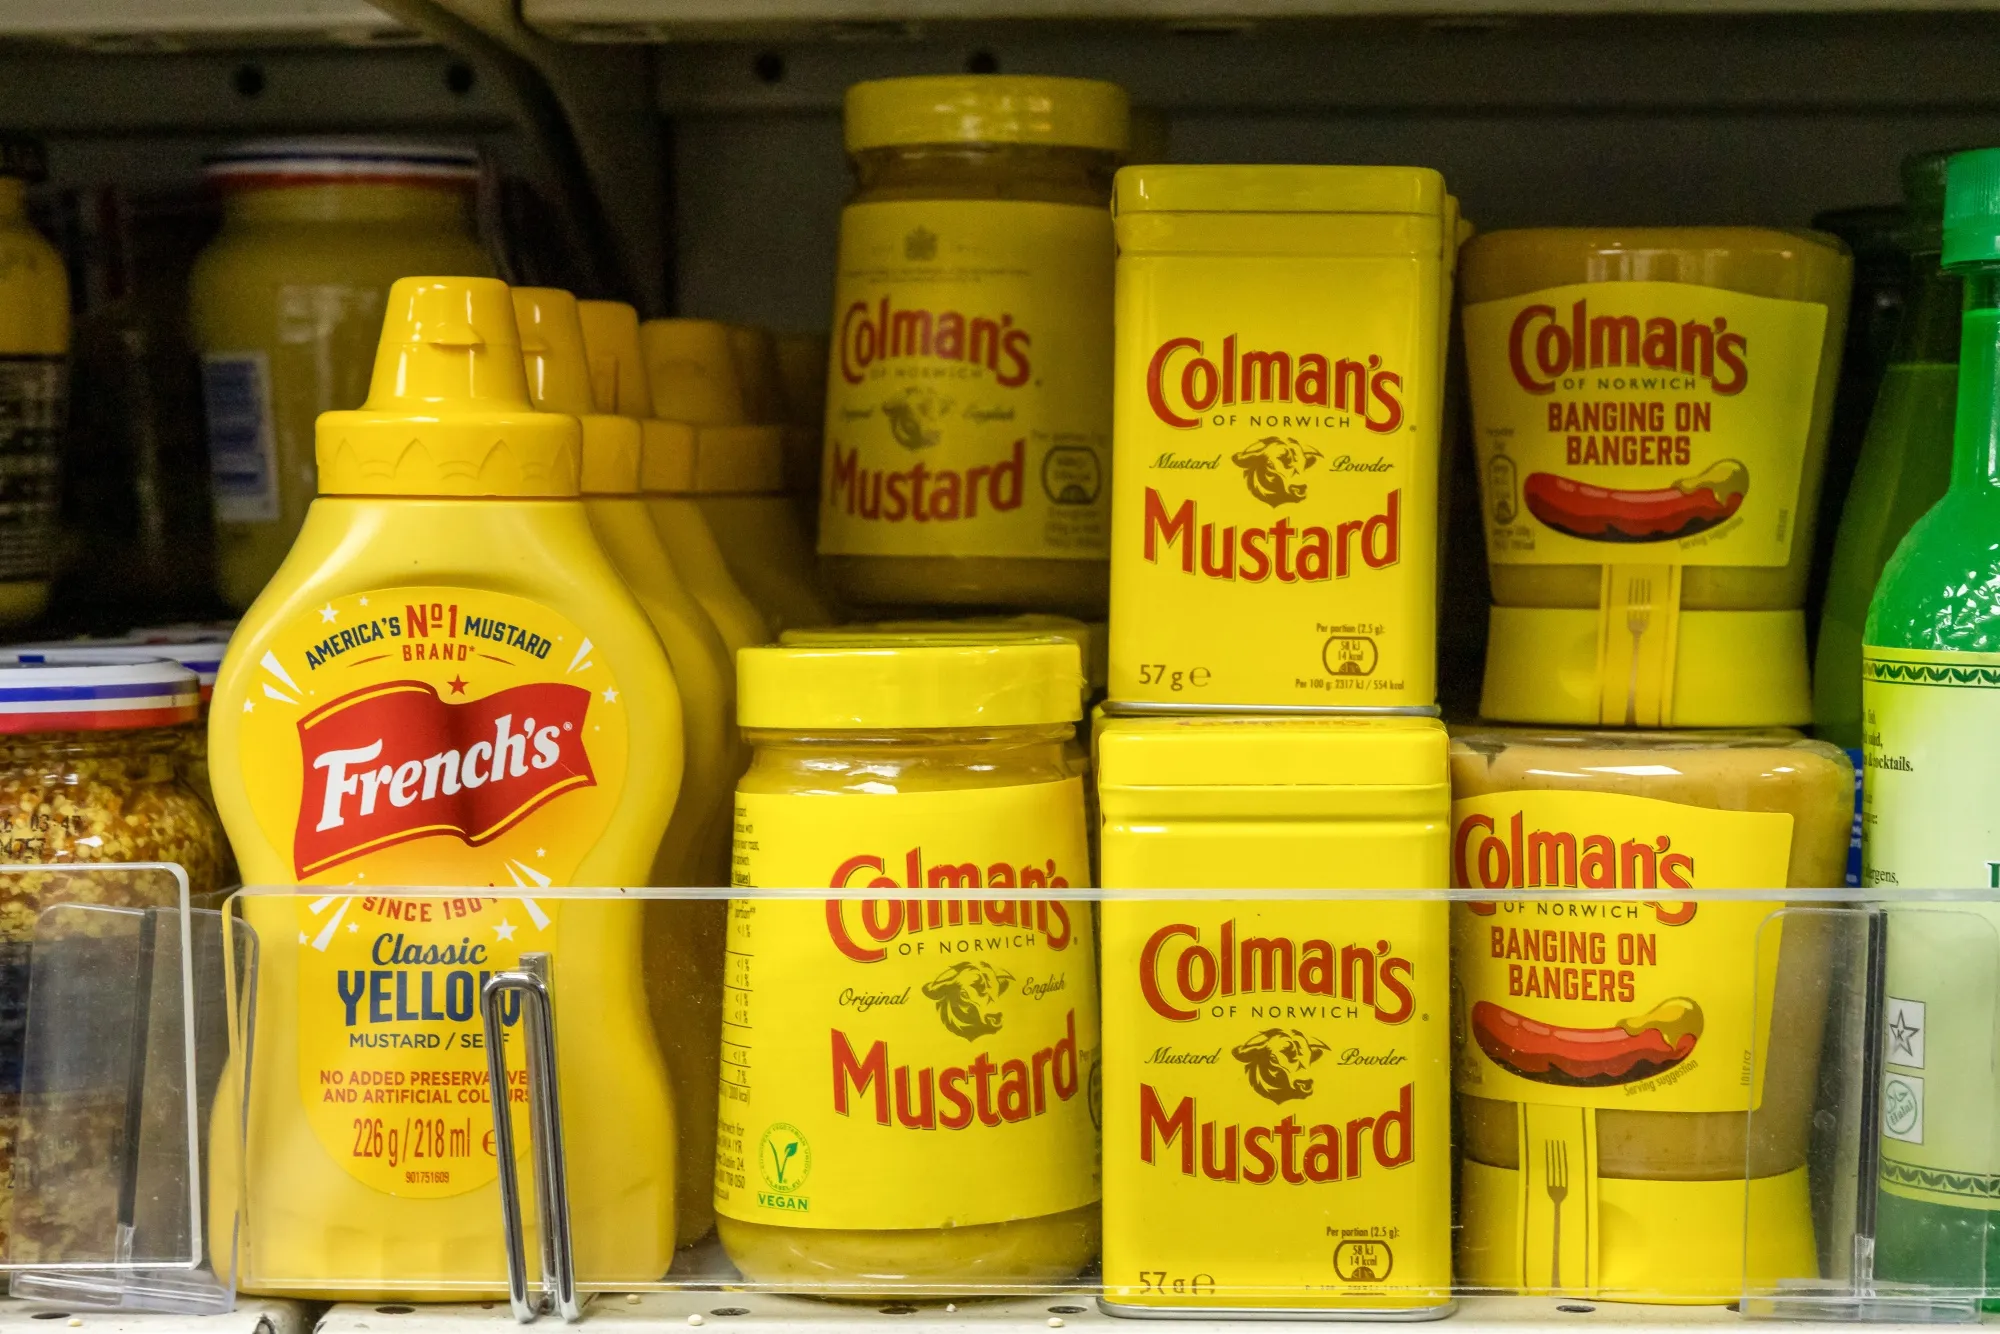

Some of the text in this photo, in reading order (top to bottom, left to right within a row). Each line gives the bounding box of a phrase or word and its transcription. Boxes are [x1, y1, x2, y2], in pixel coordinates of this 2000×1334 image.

[840, 294, 1030, 388] Colman's
[1508, 298, 1747, 396] Colman's
[1146, 332, 1403, 434] Colman's
[1563, 377, 1696, 390] OF NORWICH
[1212, 414, 1350, 428] OF NORWICH
[1547, 401, 1711, 432] BANGING ON
[1148, 452, 1394, 473] Mustard Powder
[1566, 435, 1690, 465] BANGERS
[829, 438, 1026, 523] Mustard
[1144, 486, 1402, 584] Mustard
[305, 615, 401, 670] AMERICA'S
[464, 615, 553, 660] MUSTARD
[1138, 664, 1166, 684] 57
[1170, 670, 1184, 691] g
[313, 713, 561, 832] French's
[1454, 810, 1698, 926] Colman's
[362, 883, 497, 922] SINCE 190
[826, 846, 1071, 962] Colman's
[1503, 901, 1639, 919] OF NORWICH
[371, 933, 488, 966] Classic
[898, 934, 1036, 956] OF NORWICH
[1491, 926, 1657, 966] BANGING ON
[1139, 917, 1415, 1026] Colman's
[1509, 963, 1636, 1003] BANGERS
[839, 973, 1067, 1012] Original English
[1211, 1005, 1359, 1019] OF NORWICH
[350, 1032, 510, 1051] MUSTARD / SEF
[1144, 1046, 1408, 1067] Mustard Powder
[320, 1070, 528, 1087] NO ADDED PRESERVAVE
[831, 1008, 1078, 1131] Mustard
[1623, 1059, 1699, 1097] Serving suggestion
[323, 1088, 530, 1105] AND ARTIFICIAL COLUR
[353, 1118, 383, 1159] 226
[413, 1118, 445, 1159] 218
[449, 1118, 471, 1158] ml
[1140, 1082, 1415, 1186] Mustard
[758, 1193, 808, 1210] VEGAN
[1326, 1226, 1339, 1237] Per
[1341, 1227, 1368, 1239] portion
[1350, 1255, 1359, 1266] 14
[1353, 1245, 1362, 1255] 58
[1139, 1271, 1167, 1295] 57
